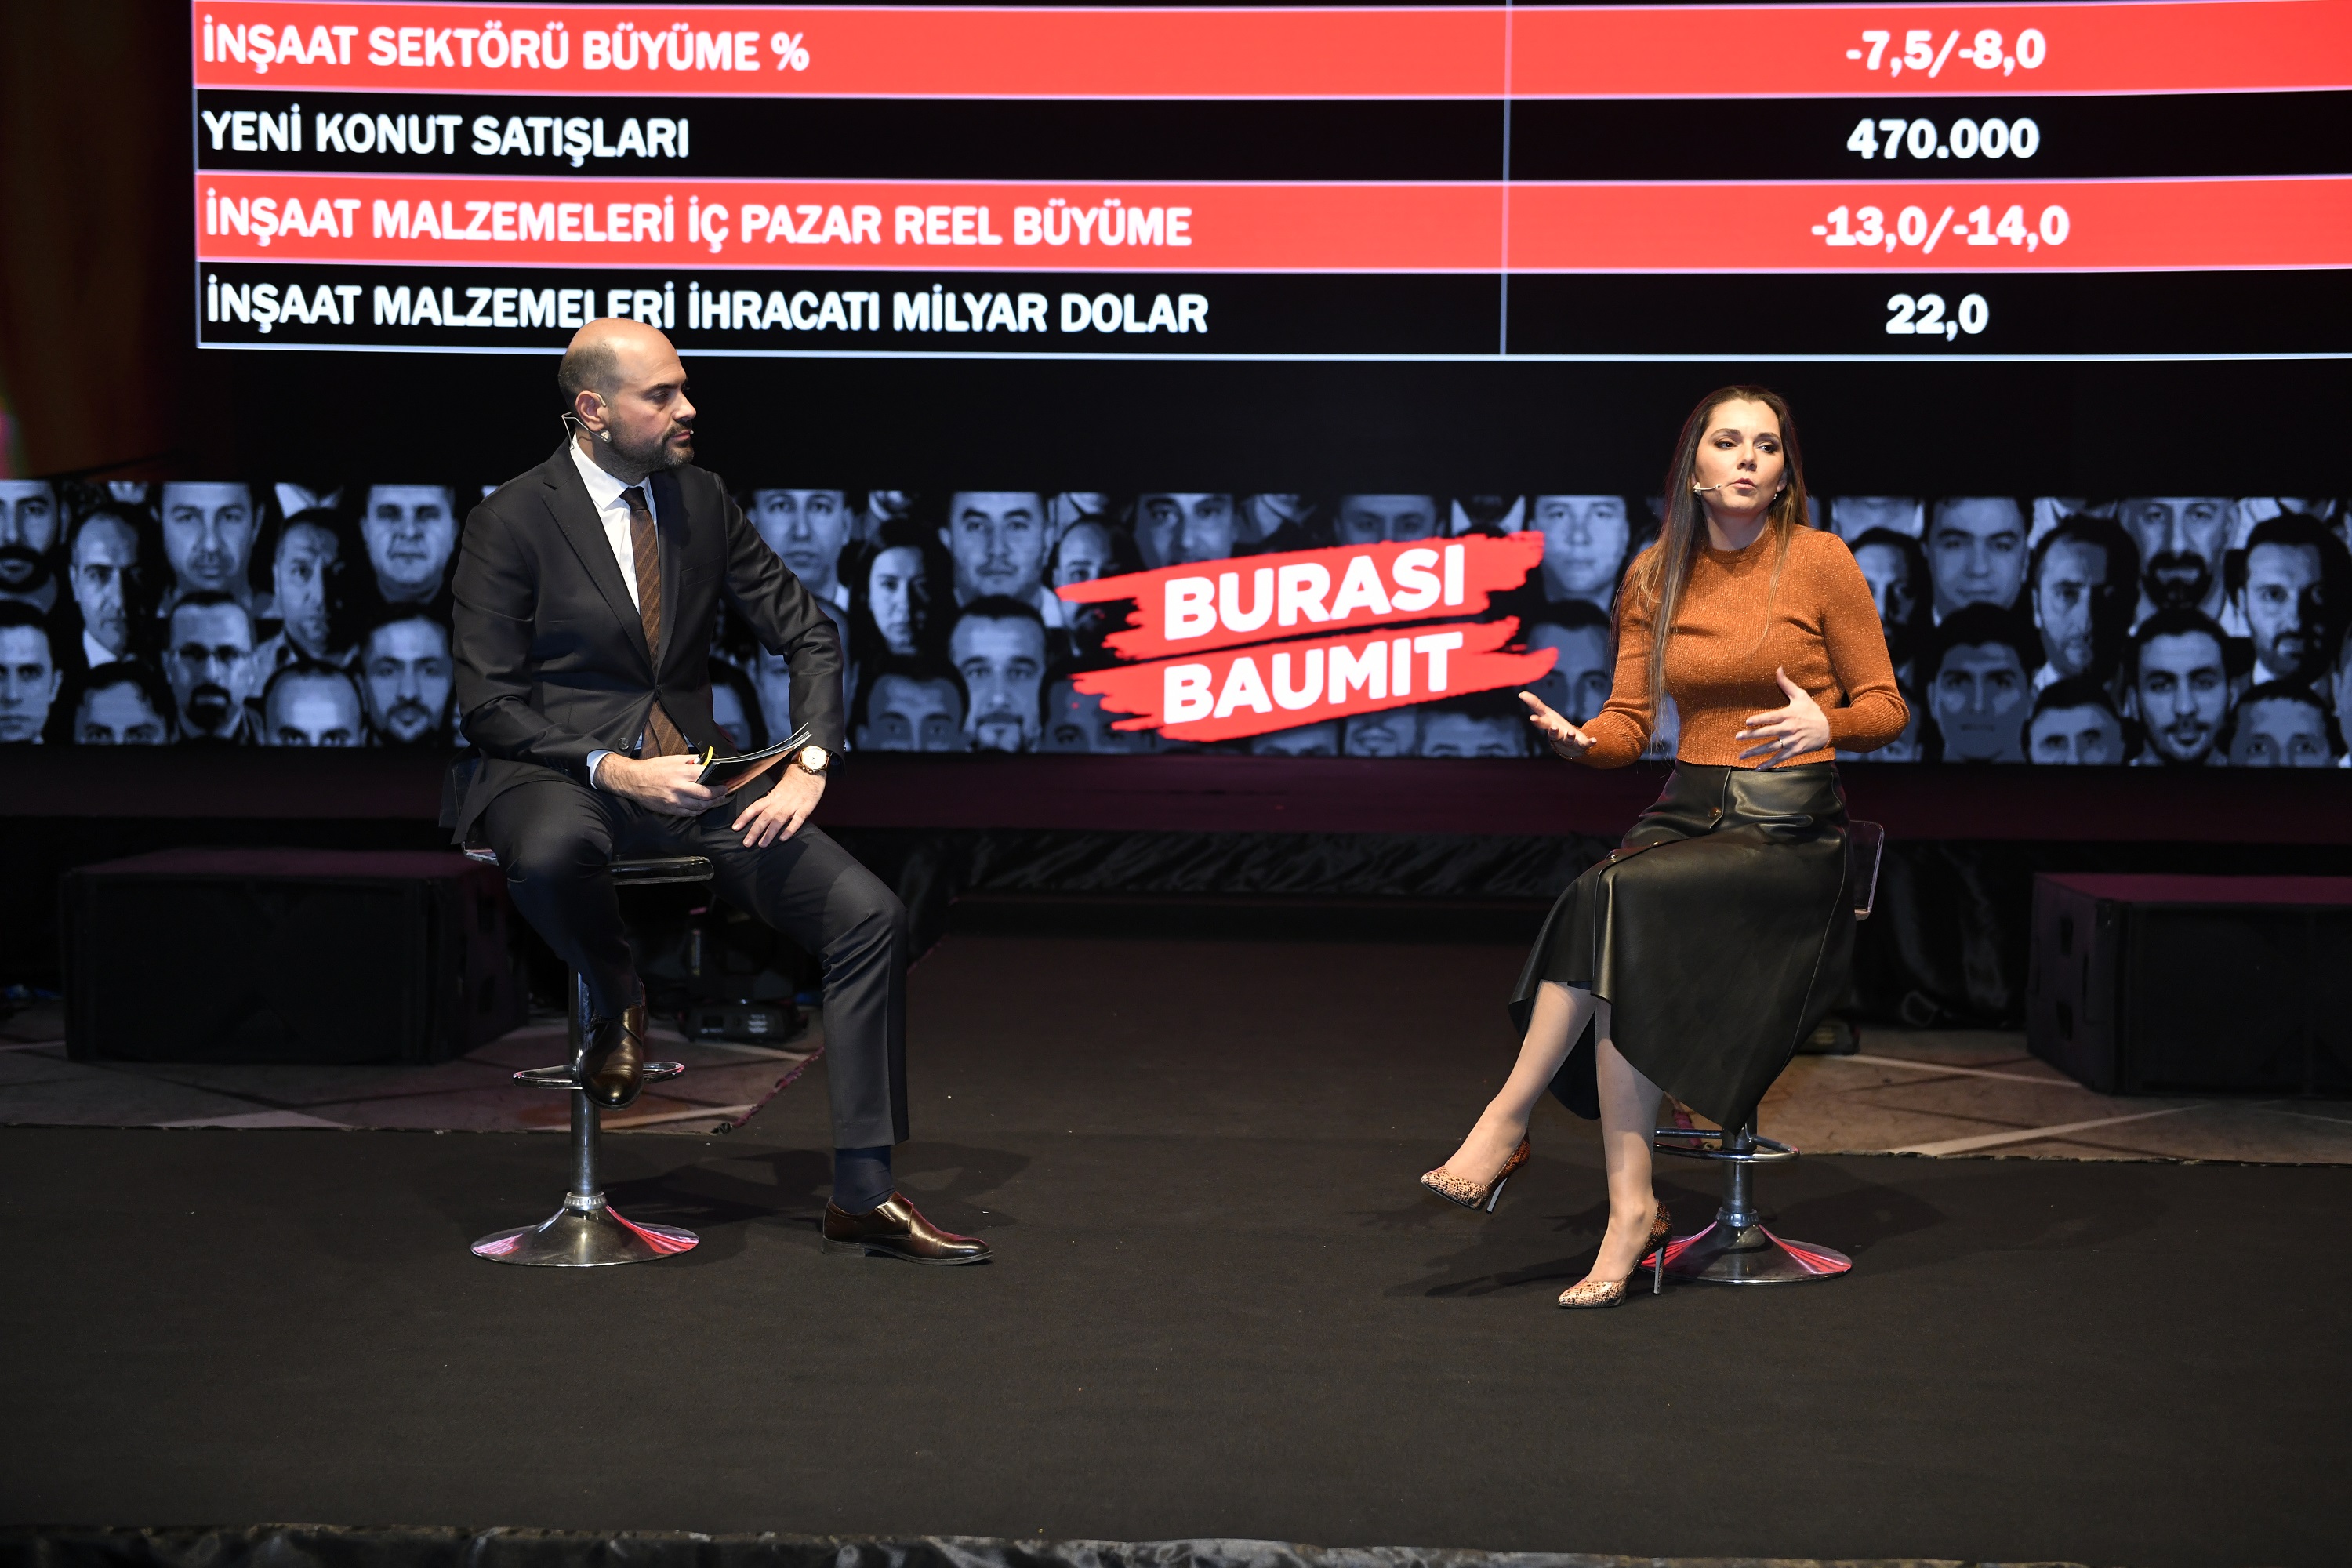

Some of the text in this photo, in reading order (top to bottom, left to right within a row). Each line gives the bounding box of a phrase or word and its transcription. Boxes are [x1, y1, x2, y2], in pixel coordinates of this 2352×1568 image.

[203, 15, 811, 74] İNŞAAT SEKTÖRÜ BÜYÜME %
[1846, 28, 2047, 78] -7,5/-8,0
[201, 103, 689, 168] YENİ KONUT SATIŞLARI
[1846, 117, 2040, 159] 470.000
[205, 187, 1193, 254] İNŞAAT MALZEMELERİ İÇ PAZAR REEL BÜYÜME
[1811, 205, 2071, 255] -13,0/-14,0
[207, 274, 1210, 334] İNŞAAT MALZEMELERİ İHRACATI MİLYAR DOLAR
[1886, 293, 1990, 342] 22,0
[1163, 544, 1465, 641] BURASI
[1163, 631, 1464, 724] BAUMIT
